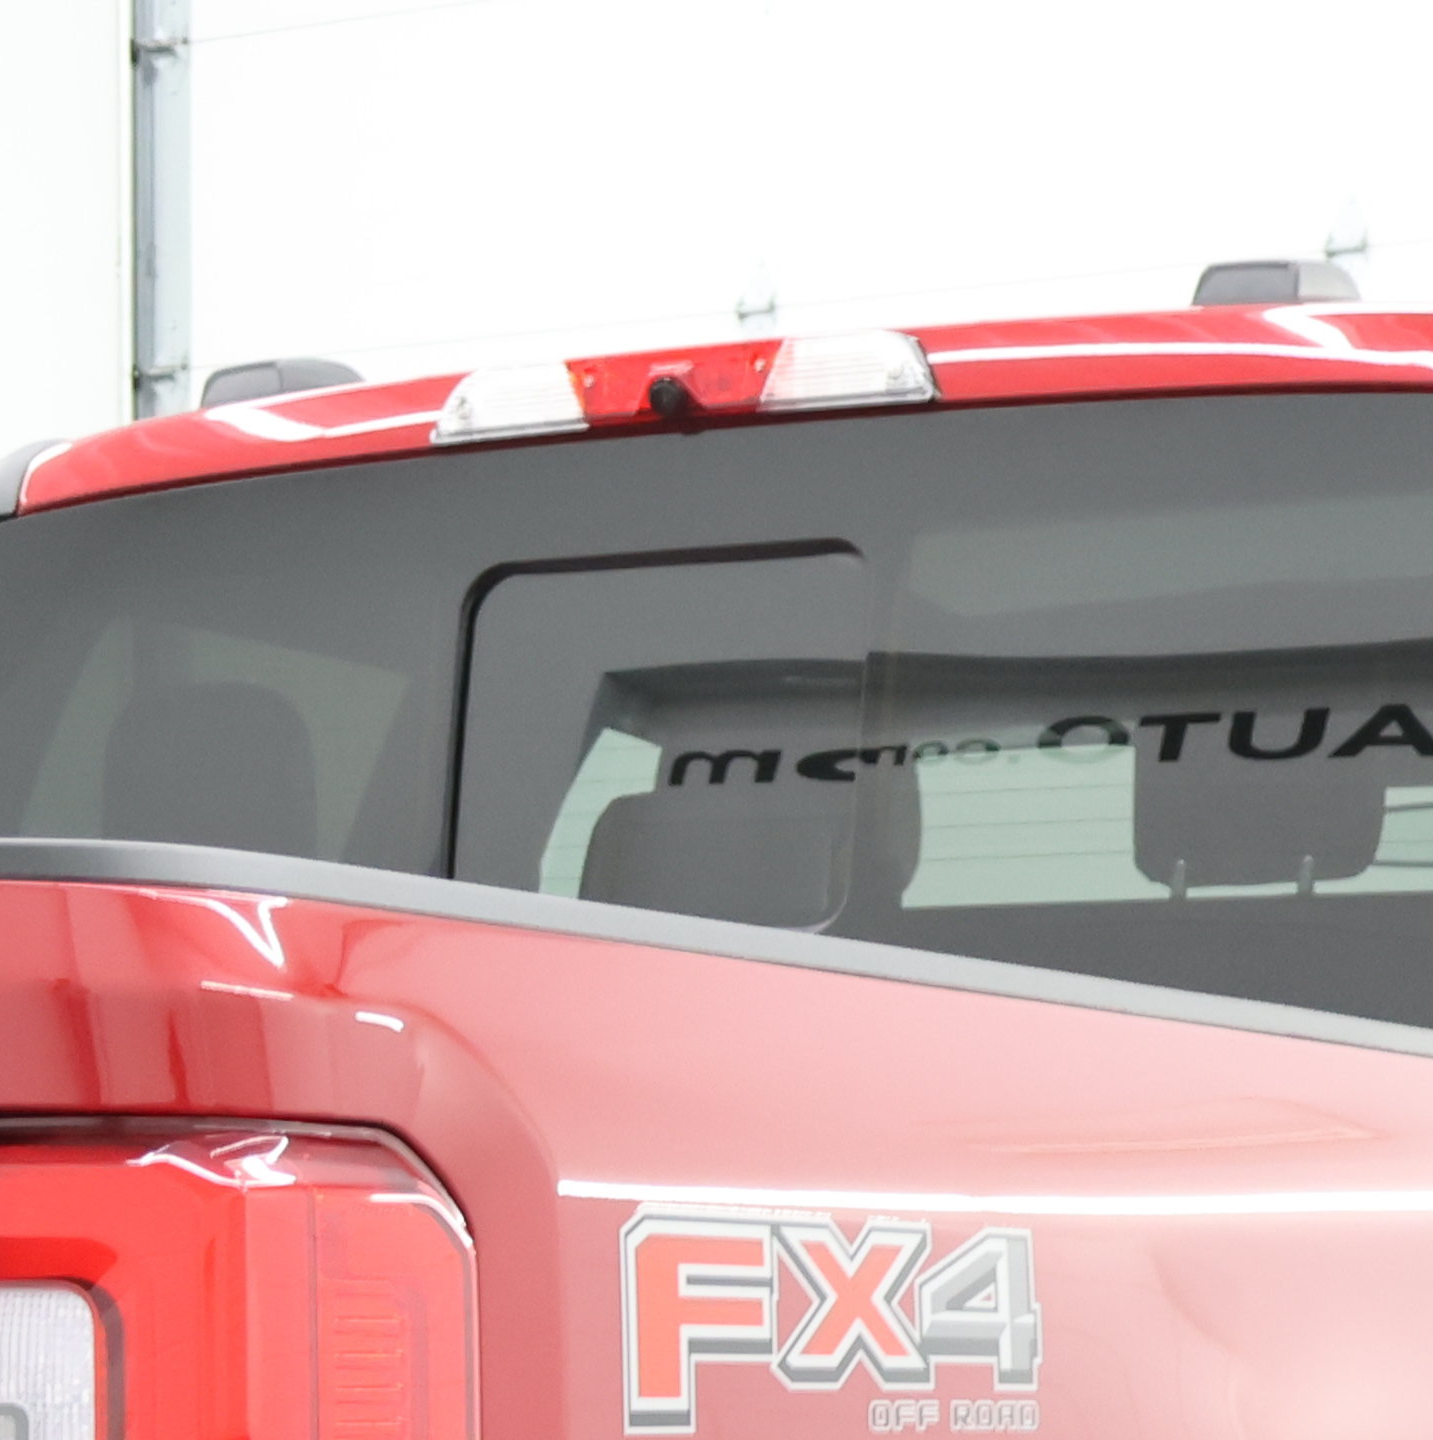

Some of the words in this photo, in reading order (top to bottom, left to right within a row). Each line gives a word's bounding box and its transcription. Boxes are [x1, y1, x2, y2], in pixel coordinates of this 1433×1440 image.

[620, 1206, 1043, 1436] FX4
[868, 1399, 939, 1435] OFF
[949, 1400, 1041, 1435] ROAD
